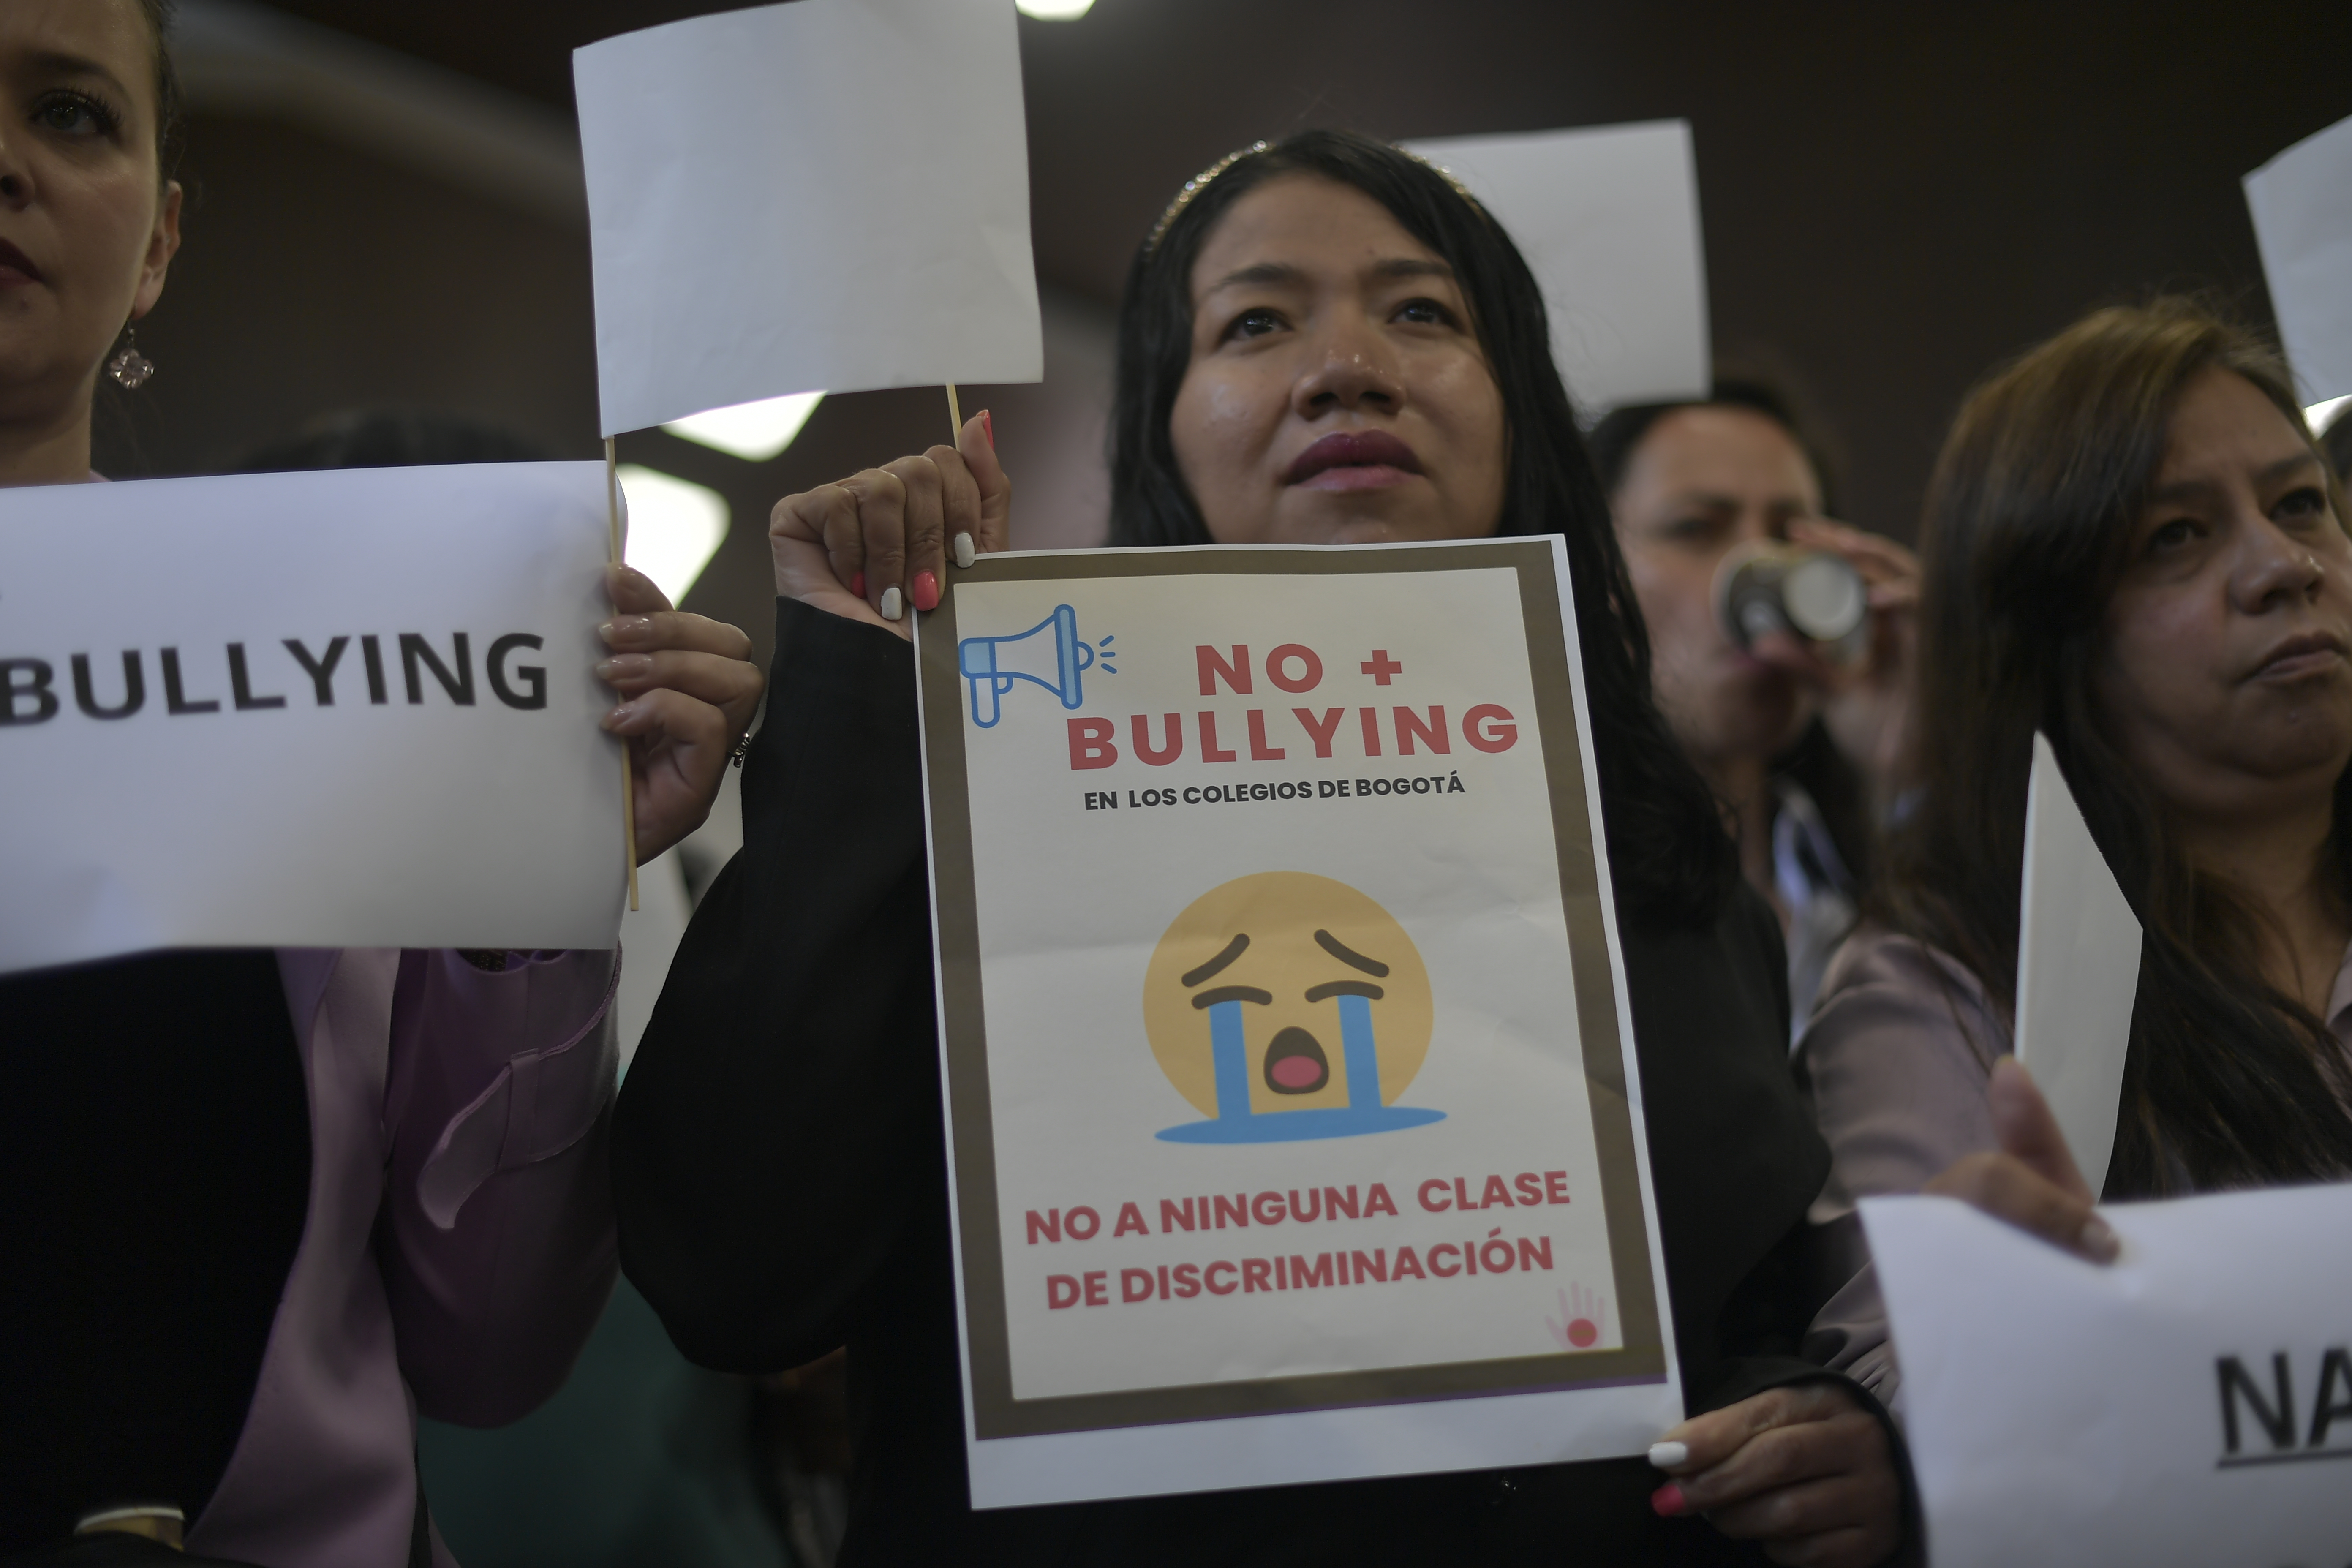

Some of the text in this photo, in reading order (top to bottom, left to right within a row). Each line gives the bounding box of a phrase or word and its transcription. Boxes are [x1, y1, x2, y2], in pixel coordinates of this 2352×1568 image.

[0, 632, 548, 727] BULLYING
[1196, 643, 1402, 696] NO +
[1067, 703, 1518, 770] BULLYING
[1084, 770, 1466, 811] EN LOS COLEGIOS DE BOGOTÁ
[1026, 1171, 1571, 1245] NO A NINGUNA CLASE
[1047, 1227, 1554, 1310] DE DISCRIMINACIÓN
